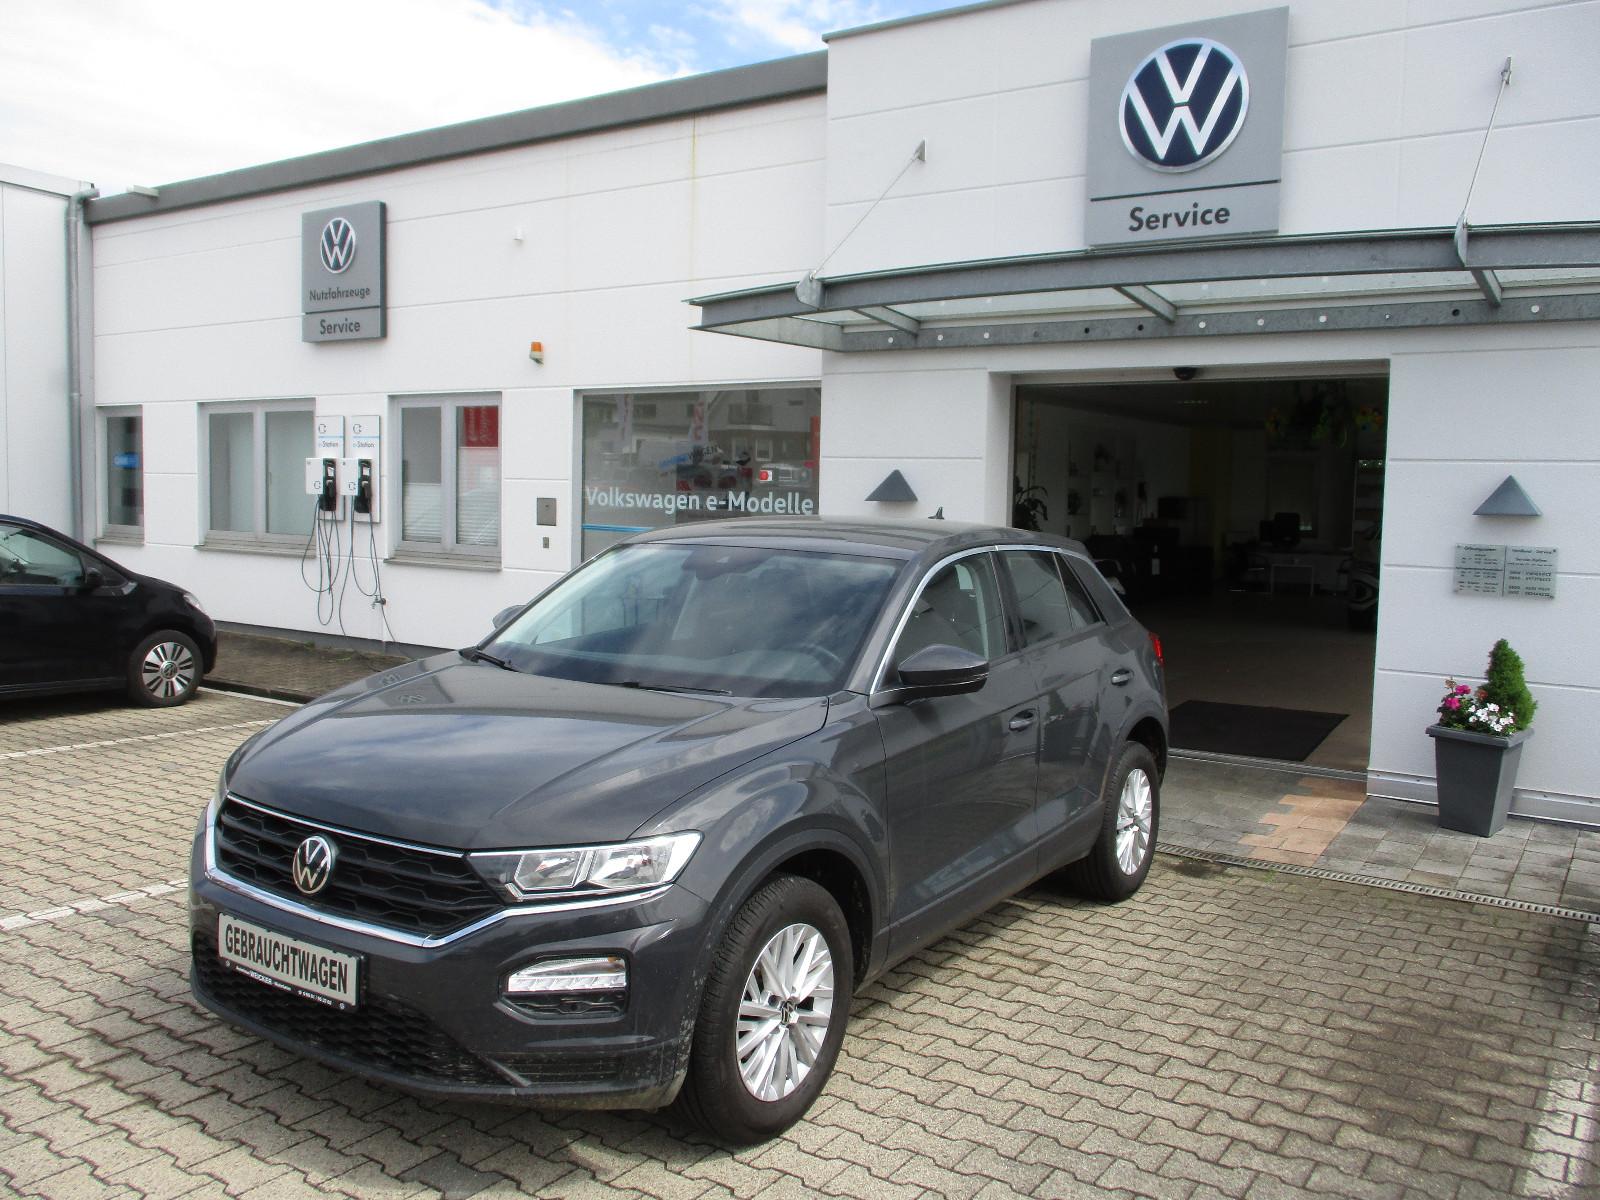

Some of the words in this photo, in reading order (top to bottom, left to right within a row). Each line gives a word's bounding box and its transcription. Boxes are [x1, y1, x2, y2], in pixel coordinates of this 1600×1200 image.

[1129, 202, 1231, 232] Service
[309, 286, 370, 302] Nutzfahrzeuge
[319, 318, 361, 335] Service
[585, 485, 700, 515] Volkswagen
[705, 490, 814, 515] e-Modelle
[225, 923, 348, 994] GEBRAUCHTWAGEN
